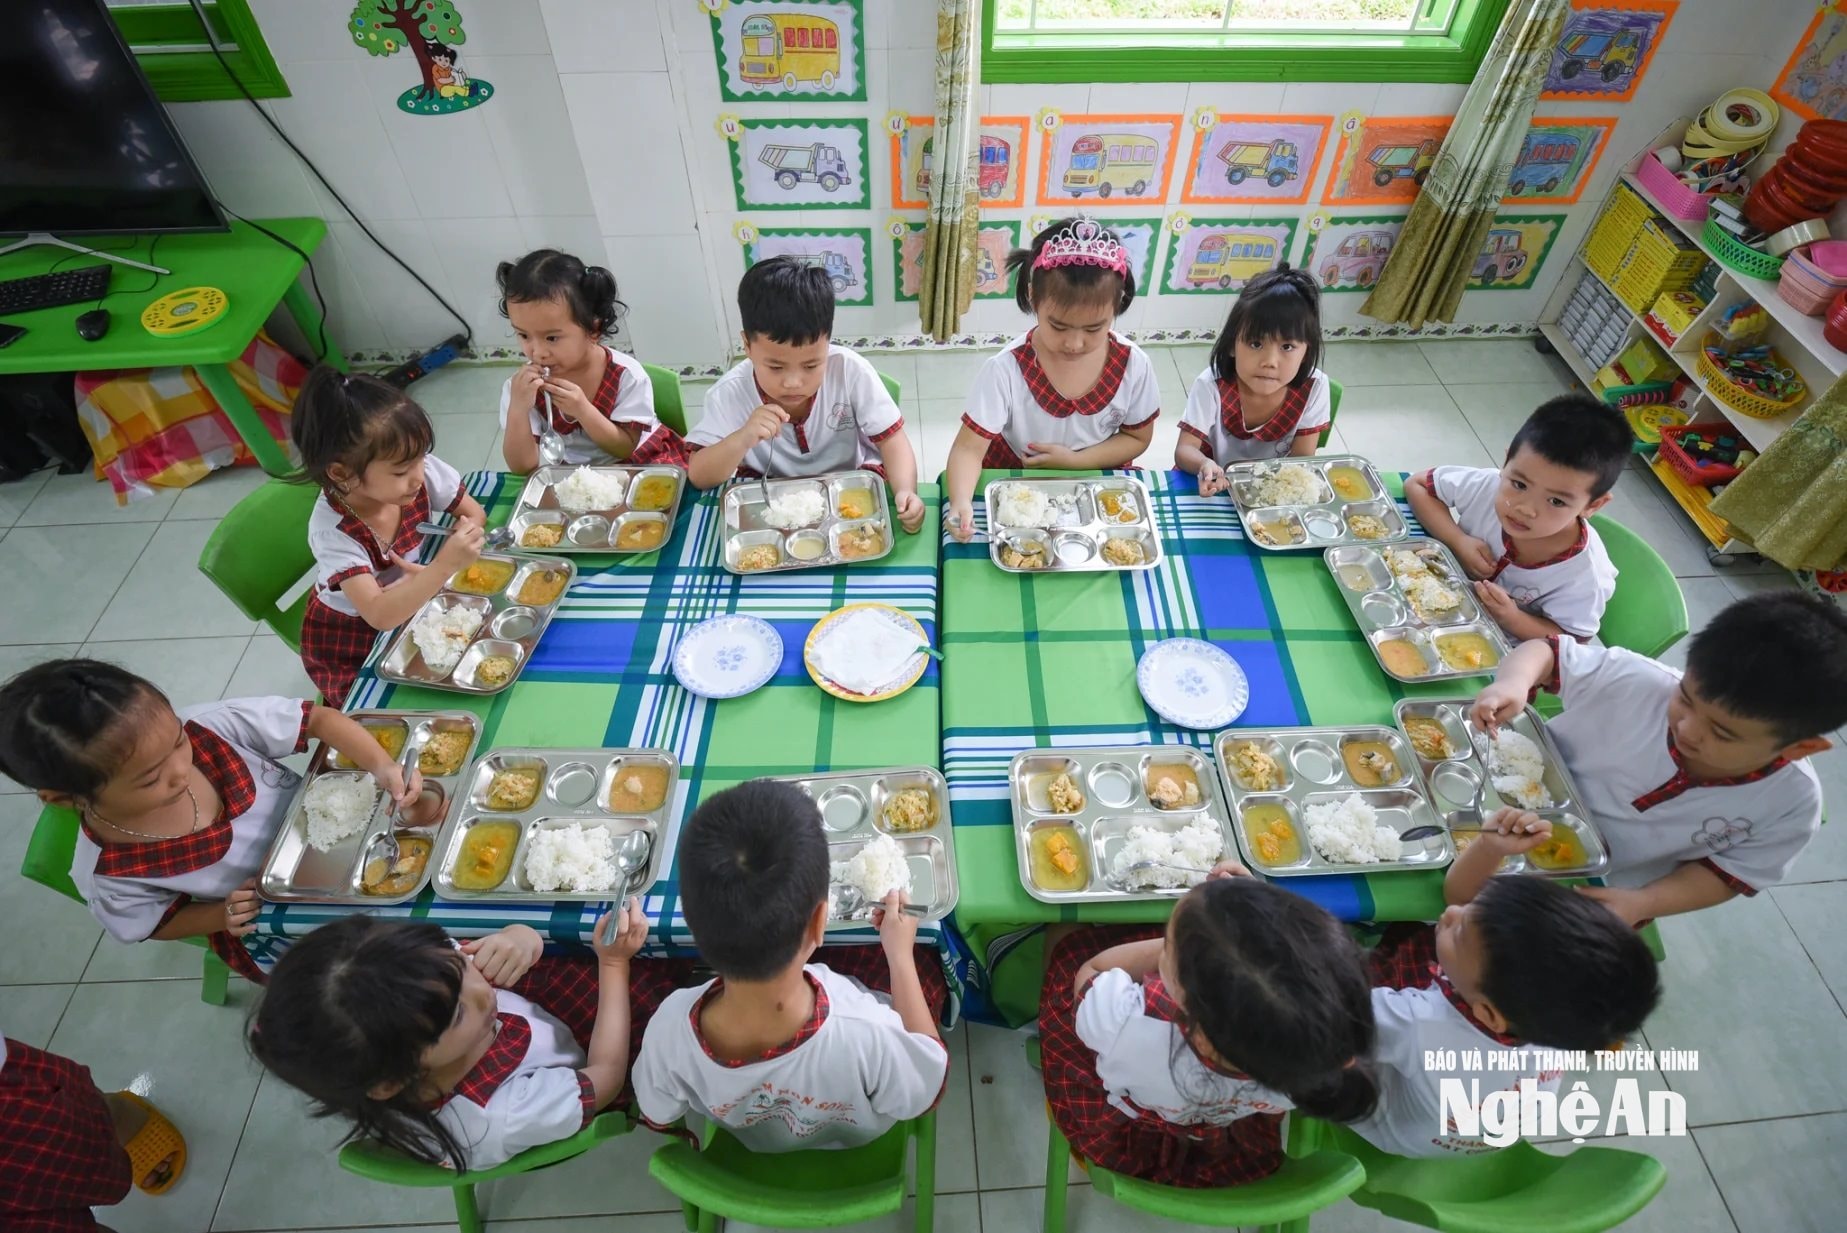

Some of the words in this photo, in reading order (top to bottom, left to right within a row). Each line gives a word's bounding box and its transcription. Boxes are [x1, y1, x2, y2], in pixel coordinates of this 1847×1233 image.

[1045, 116, 1054, 126] a
[1200, 115, 1210, 125] n
[725, 122, 735, 133] u
